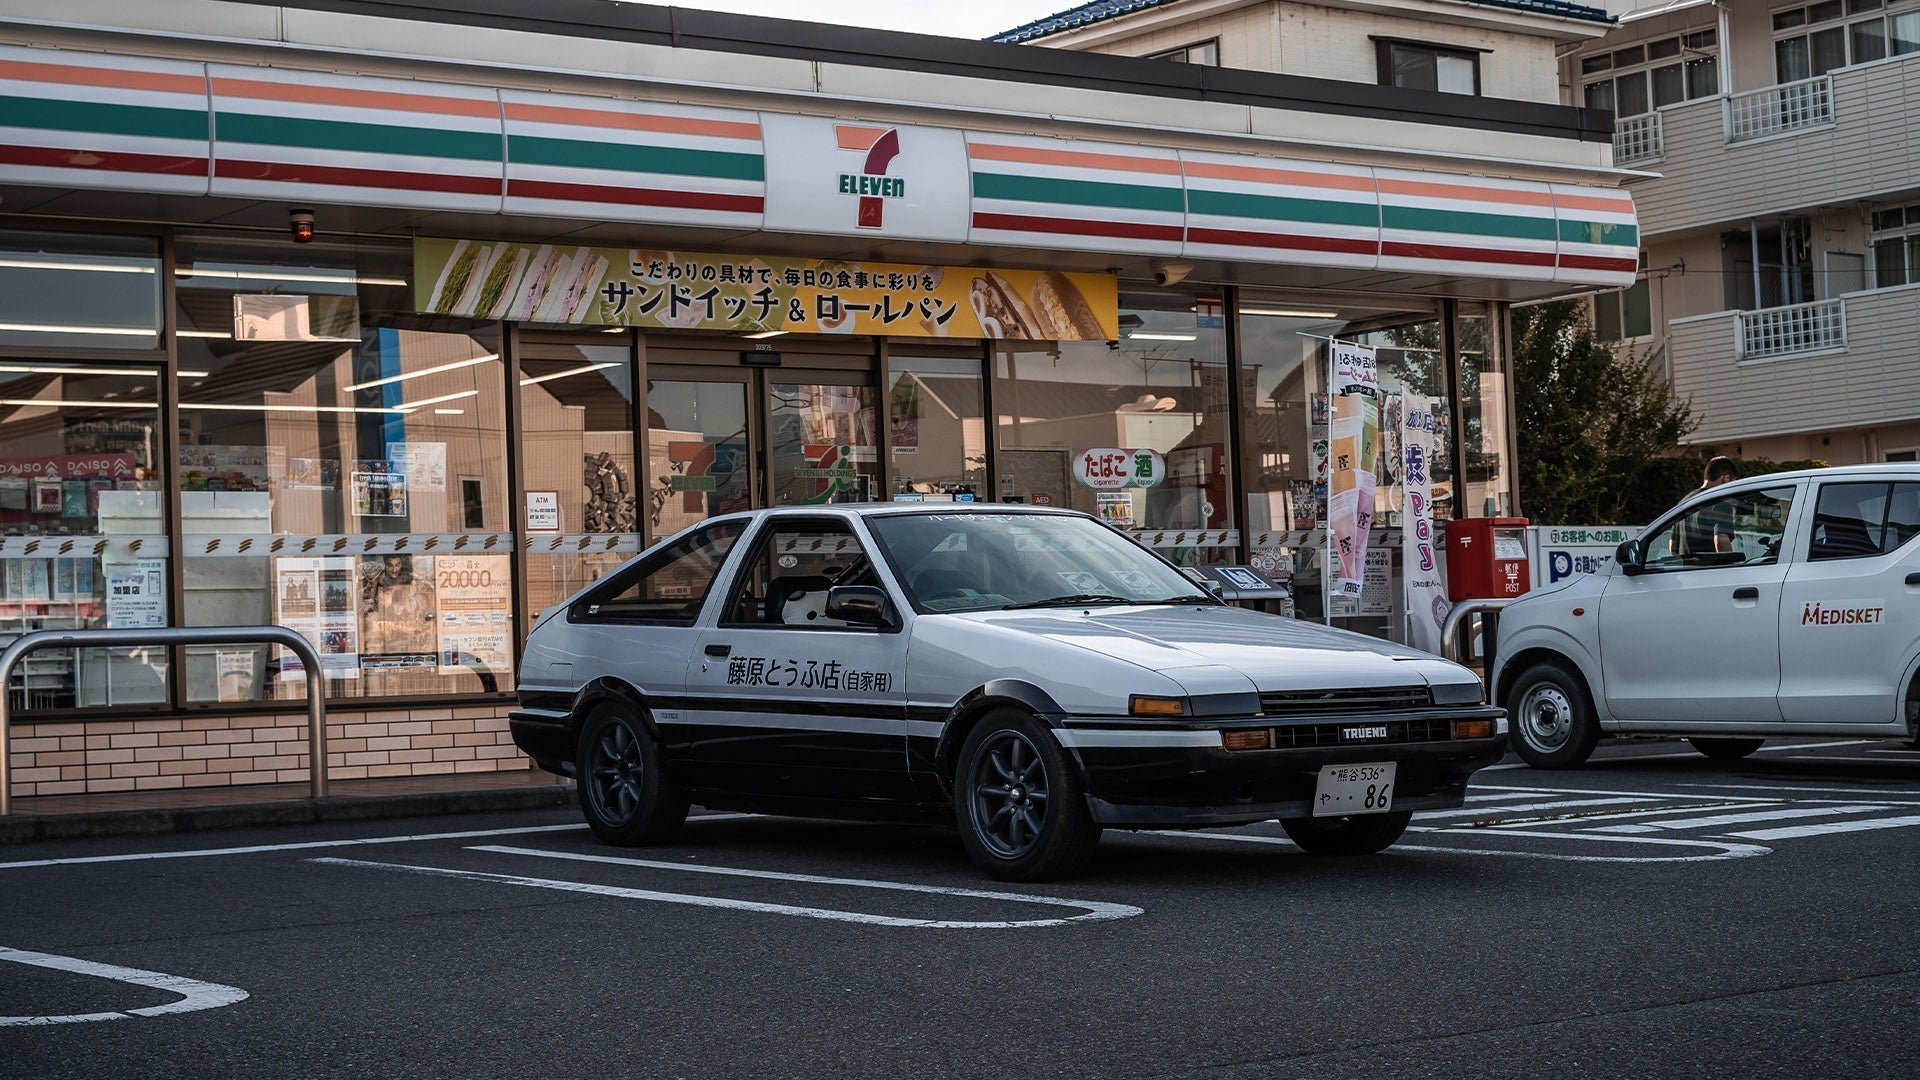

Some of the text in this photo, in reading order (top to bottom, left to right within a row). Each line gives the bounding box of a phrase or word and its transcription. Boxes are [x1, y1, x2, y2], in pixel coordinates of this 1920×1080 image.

[632, 261, 934, 291] こだわりの具材で、毎日の食事に彩りを
[601, 282, 957, 325] サンドイッチ & ロールパン
[68, 460, 110, 471] DAISO
[1085, 454, 1153, 478] たばこ 酒
[1094, 479, 1120, 487] cigarette
[1561, 531, 1629, 543] お客様へのお願い
[1505, 563, 1519, 574] 郵便
[113, 586, 140, 595] 加盟店
[1506, 583, 1520, 592] POST
[1802, 603, 1883, 625] MEDISKET
[727, 656, 893, 693] 藤原とうふ店(自家用)
[1343, 727, 1387, 739] TRUENO
[1337, 767, 1379, 782] 熊谷 536
[1364, 783, 1390, 809] 86
